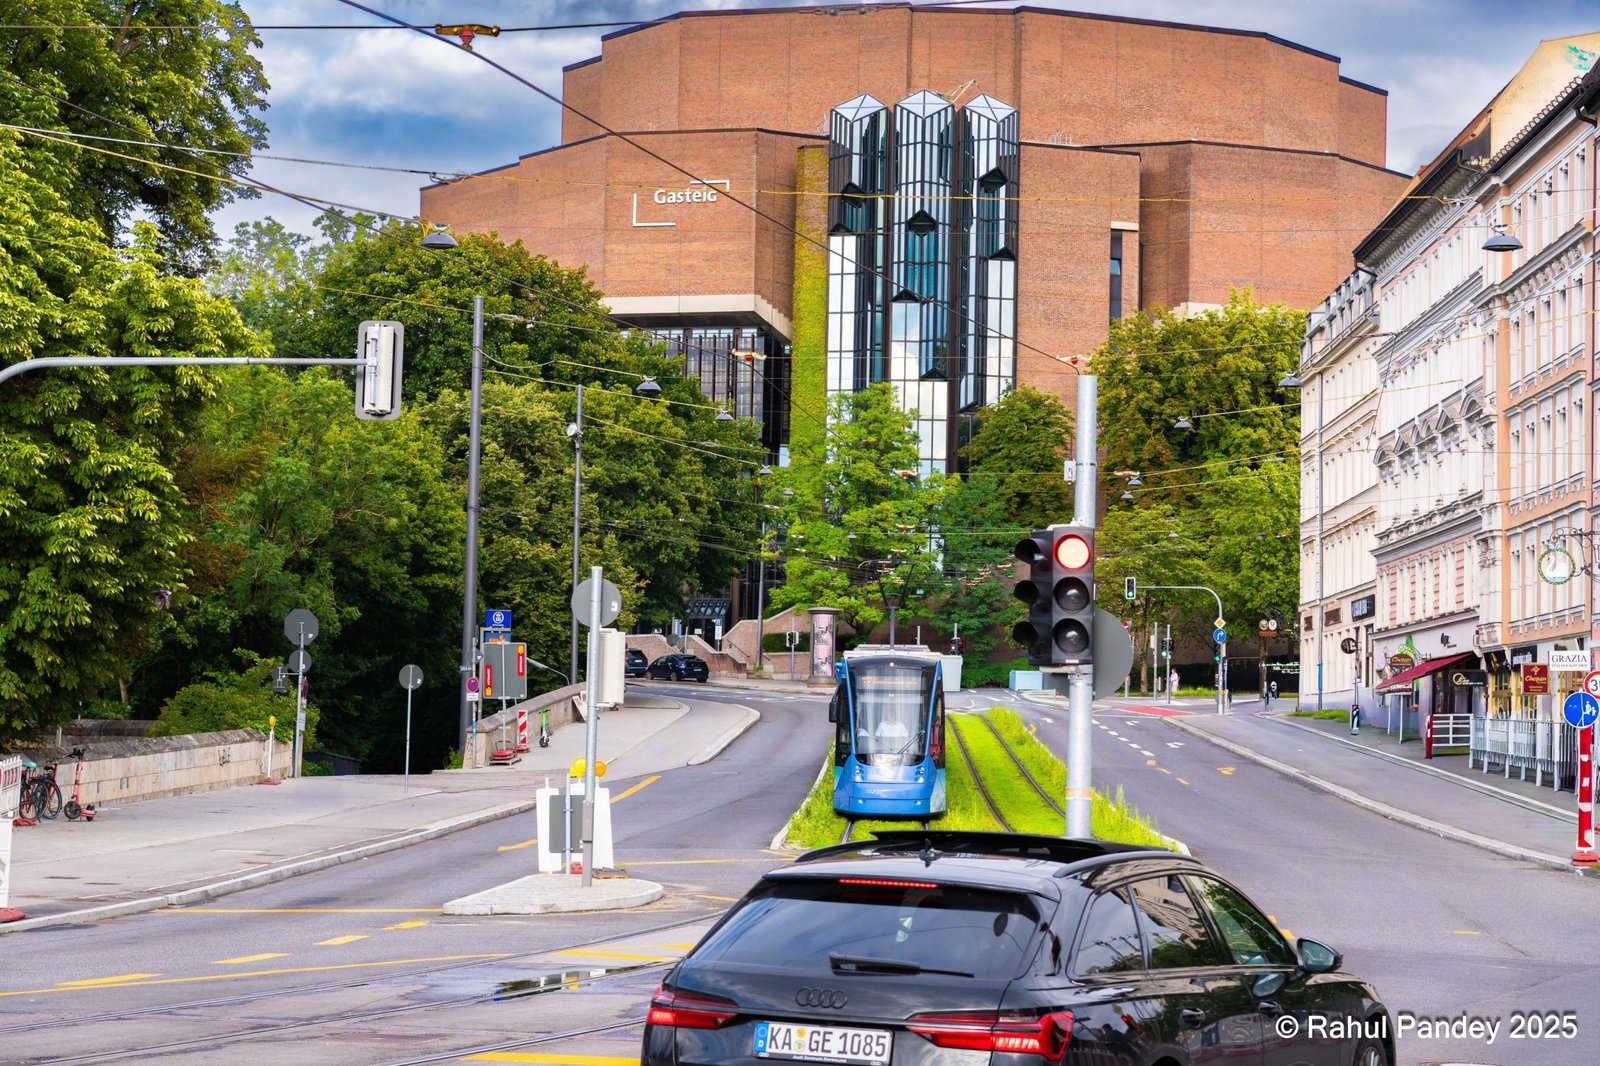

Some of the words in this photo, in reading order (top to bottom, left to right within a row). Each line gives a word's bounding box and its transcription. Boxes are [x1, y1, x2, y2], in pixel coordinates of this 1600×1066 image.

[1551, 654, 1587, 663] GRAZIA
[1590, 679, 1600, 692] 3
[768, 1027, 792, 1051] KA
[808, 1030, 833, 1054] GE
[837, 1032, 887, 1057] 1085
